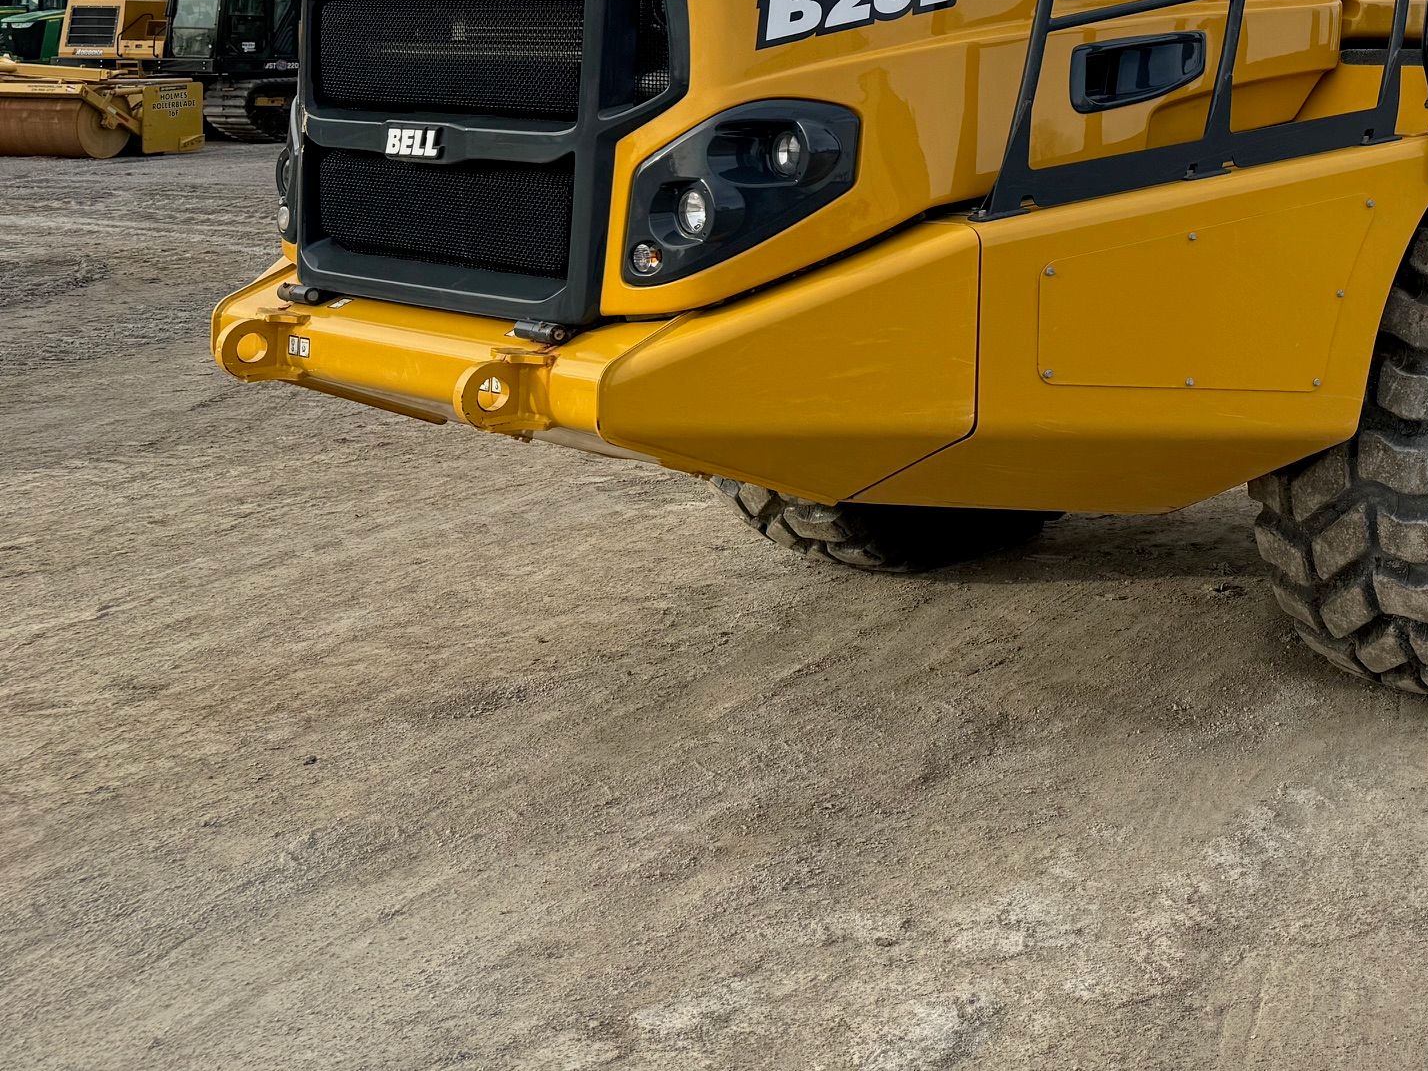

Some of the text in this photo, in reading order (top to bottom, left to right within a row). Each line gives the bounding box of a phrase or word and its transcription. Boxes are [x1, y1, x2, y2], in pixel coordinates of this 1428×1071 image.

[160, 92, 188, 100] HOLMES
[152, 100, 196, 110] ROLLERBLADE
[385, 128, 438, 156] BELL
